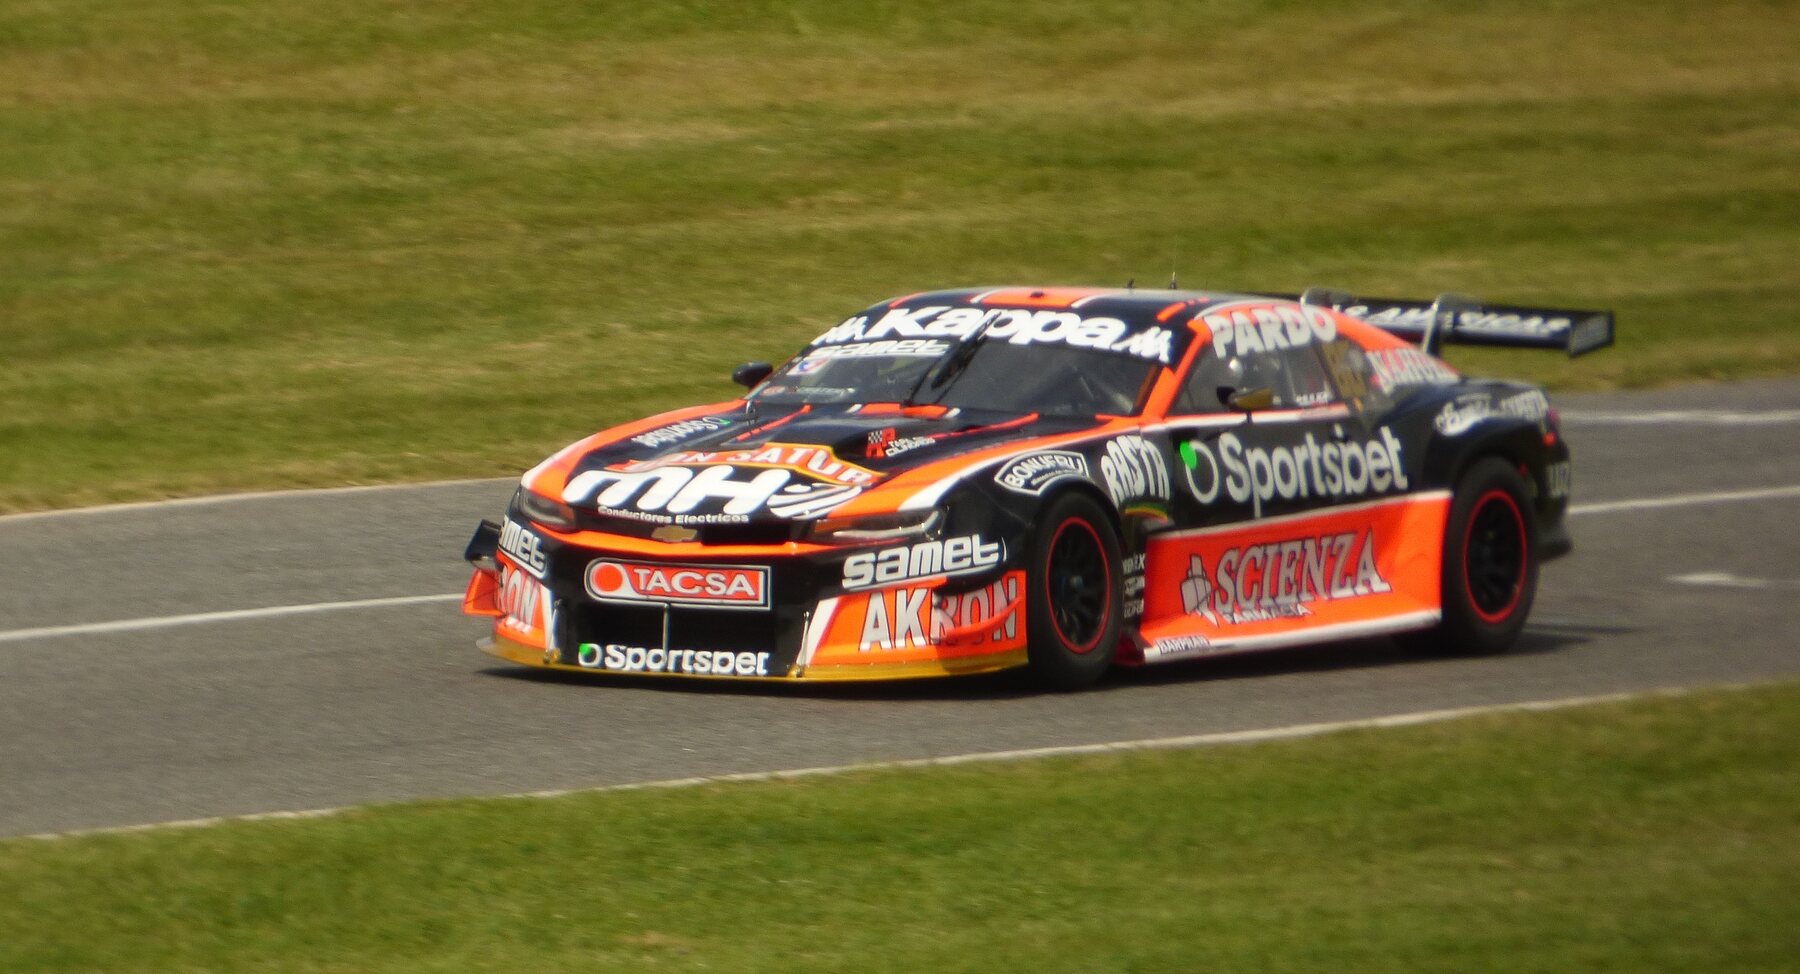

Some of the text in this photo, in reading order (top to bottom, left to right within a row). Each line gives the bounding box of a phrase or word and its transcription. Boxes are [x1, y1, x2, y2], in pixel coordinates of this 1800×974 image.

[864, 306, 1126, 350] Kappa
[1204, 305, 1337, 359] PARDO
[1101, 435, 1171, 508] RASTA
[1219, 427, 1409, 519] Sportsbet
[598, 506, 672, 524] Conductores
[633, 568, 755, 597] TACSA
[842, 534, 999, 588] samet
[1215, 530, 1392, 622] SCIENZA
[859, 576, 1017, 652] AKRON
[605, 644, 769, 676] Sportsbet
